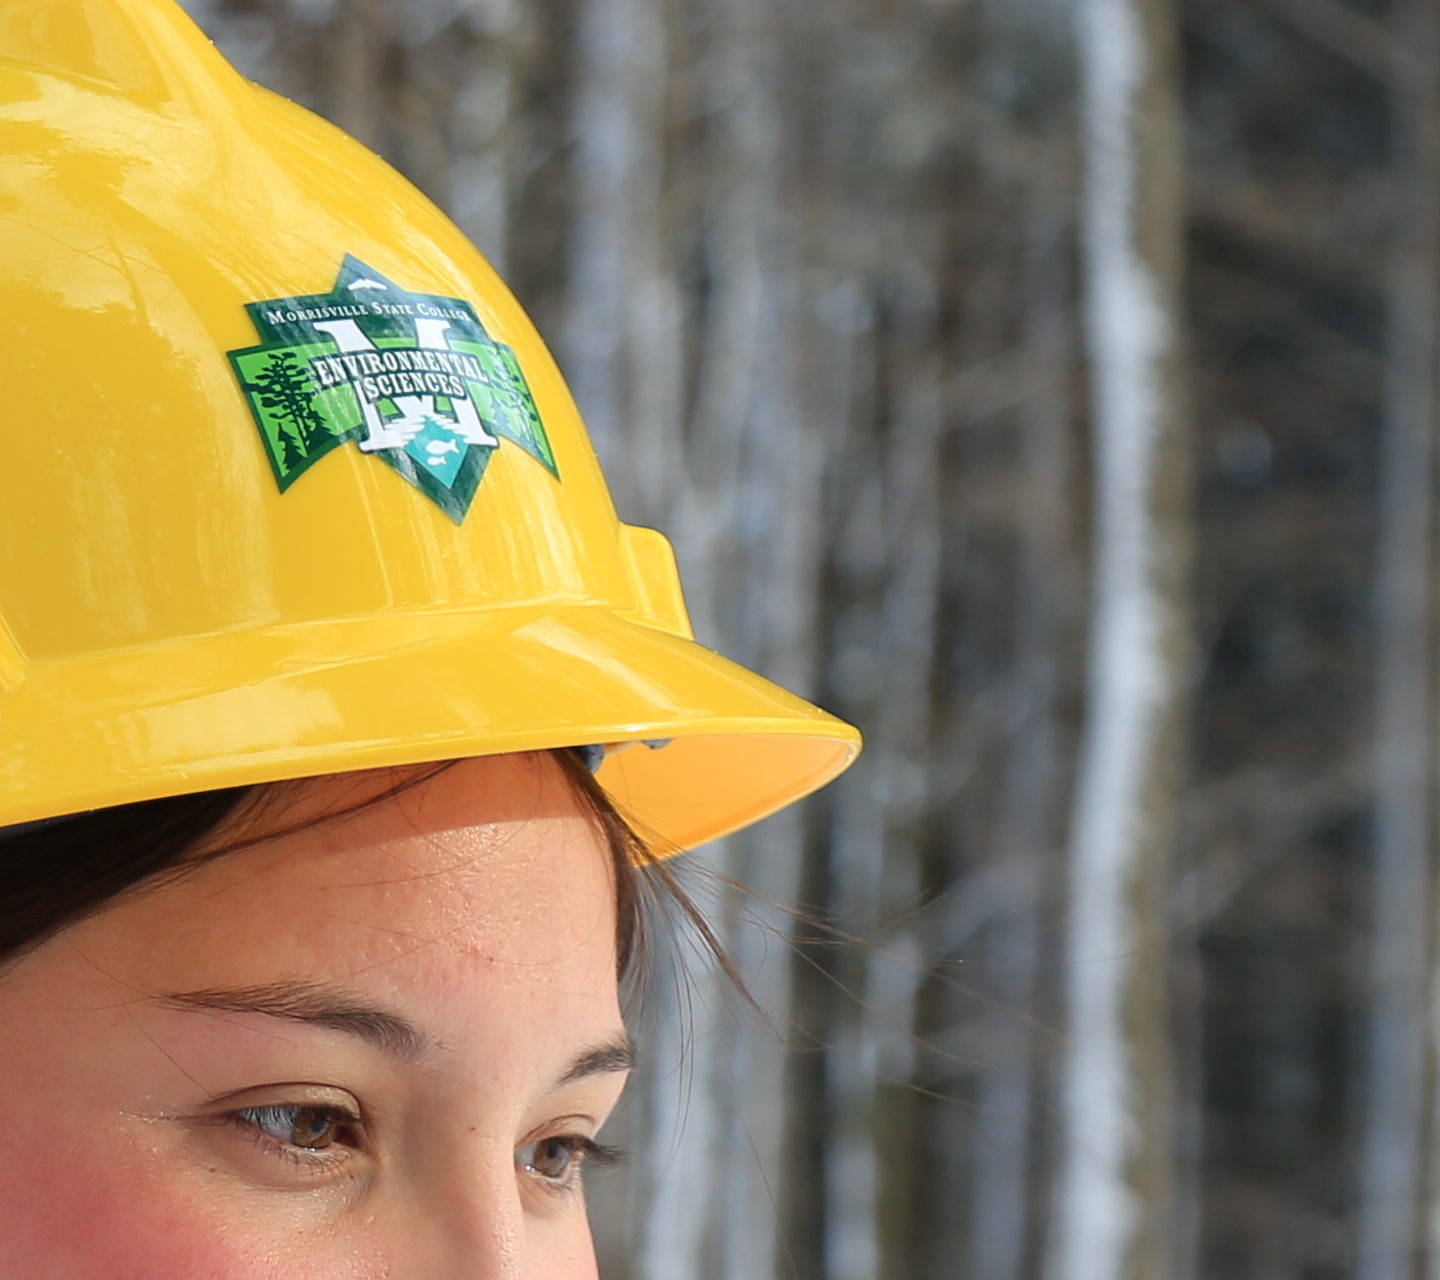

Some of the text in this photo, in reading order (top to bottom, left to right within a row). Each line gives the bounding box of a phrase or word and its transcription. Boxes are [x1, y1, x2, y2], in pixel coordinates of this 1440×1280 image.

[267, 301, 473, 325] MORRISVILLE STATE COLLEGE
[314, 351, 489, 386] ENVIRONMENTAL
[363, 373, 465, 400] SCIENCES
